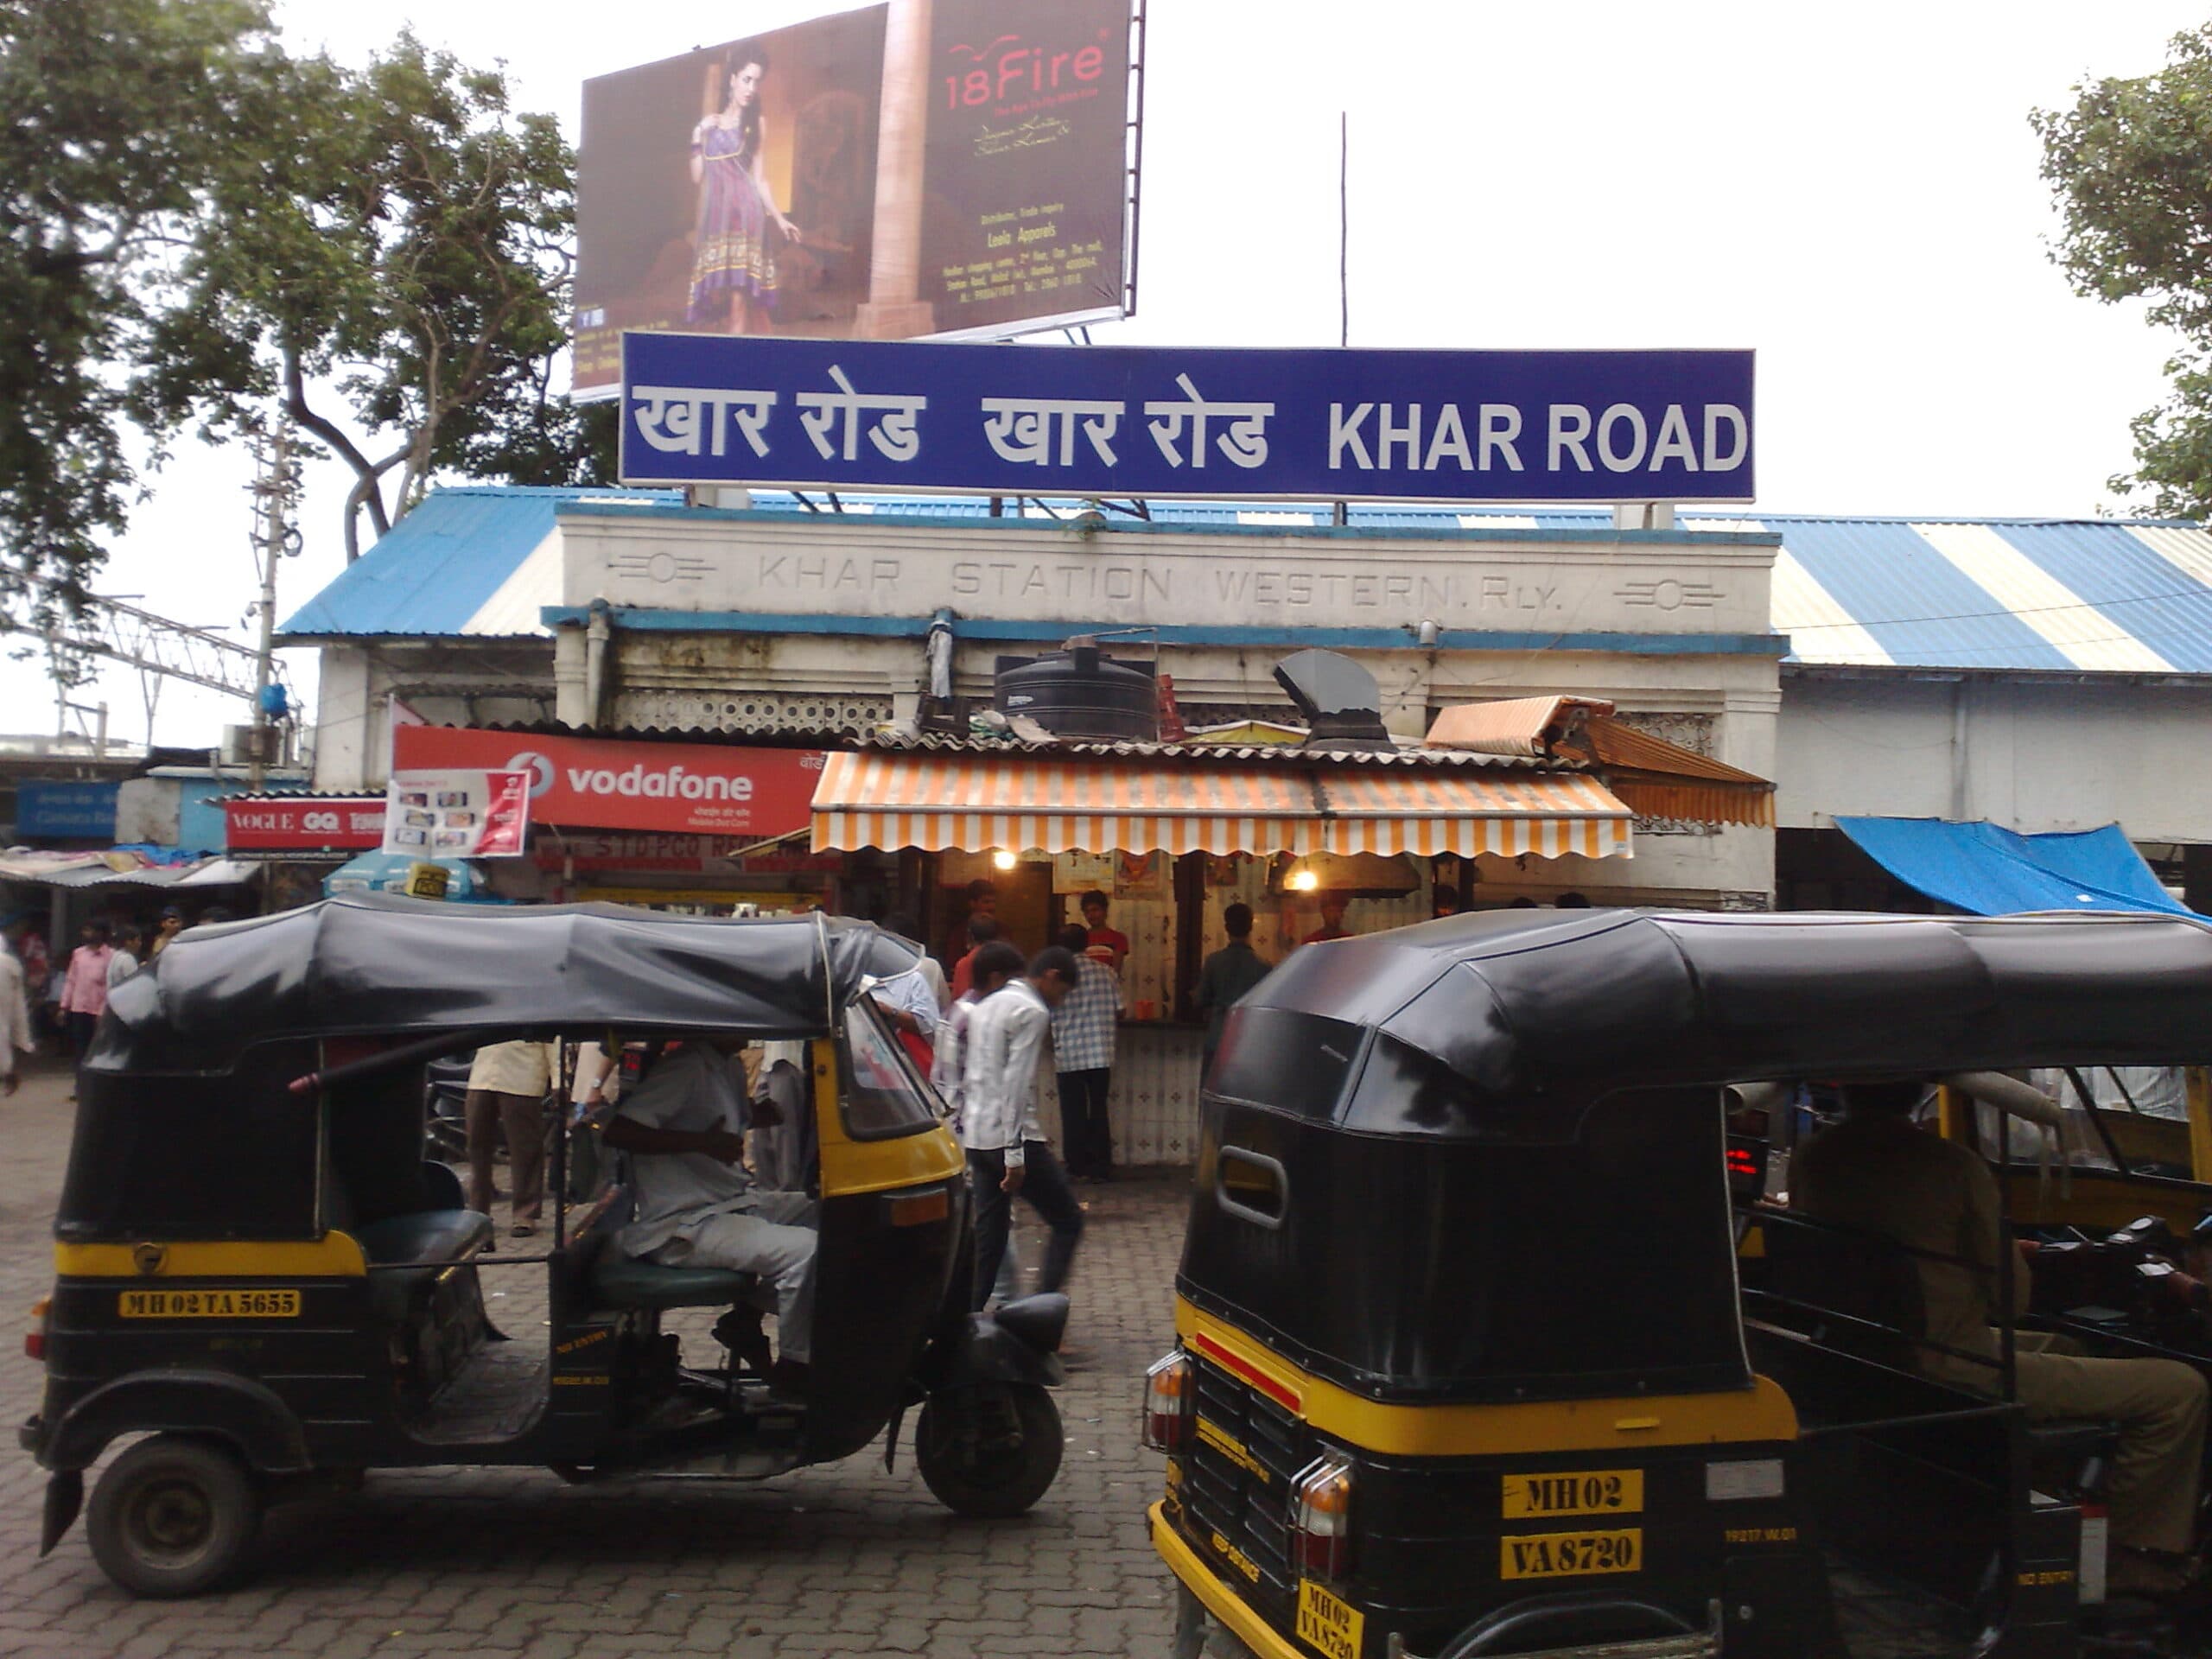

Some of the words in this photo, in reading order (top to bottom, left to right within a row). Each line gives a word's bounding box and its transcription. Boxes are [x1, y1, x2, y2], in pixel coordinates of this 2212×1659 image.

[632, 385, 777, 458] खार
[796, 365, 926, 462] रोड
[982, 397, 1125, 467] खार
[1144, 373, 1275, 469] रोड
[1328, 403, 1524, 472] KHAR
[1548, 404, 1748, 473] ROAD
[760, 555, 900, 592] KHAR
[953, 563, 1171, 601] STATION
[567, 764, 753, 800] vodafone
[232, 812, 295, 830] VOGUE
[302, 811, 340, 830] GQ
[128, 1294, 165, 1314] MH
[172, 1294, 199, 1314] 02
[204, 1294, 234, 1314] TA
[238, 1293, 296, 1314] 5655
